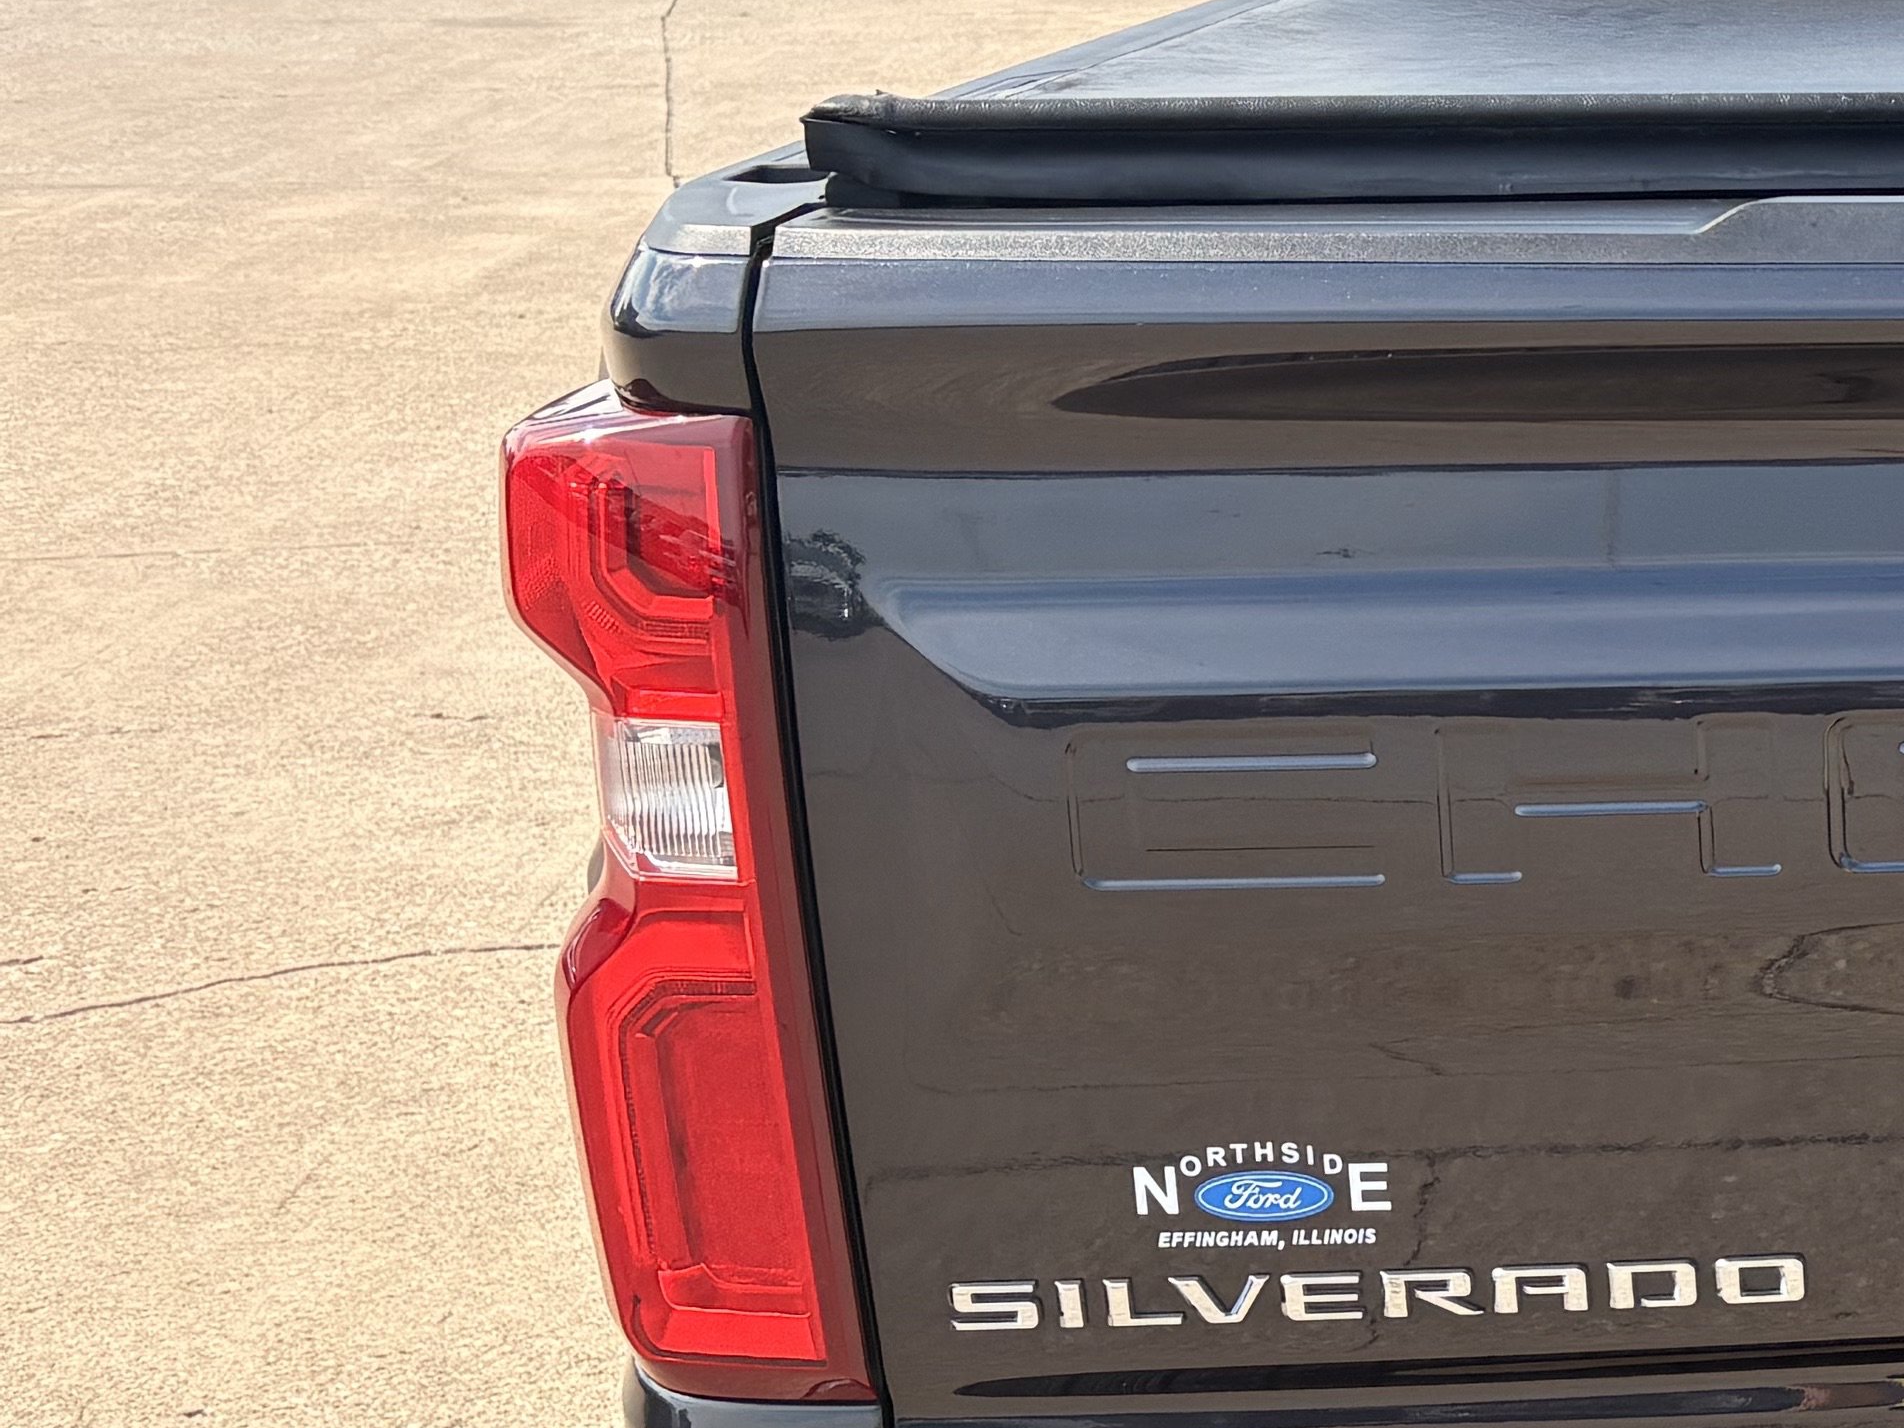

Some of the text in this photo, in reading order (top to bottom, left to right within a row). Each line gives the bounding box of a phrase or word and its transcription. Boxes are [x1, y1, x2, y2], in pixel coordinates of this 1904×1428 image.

[1132, 1141, 1392, 1216] NORTHSIDE
[1223, 1179, 1303, 1210] Ford
[1157, 1228, 1377, 1251] EFFINGHAM, ILLINOIS
[949, 1254, 1807, 1332] SILVERADO
